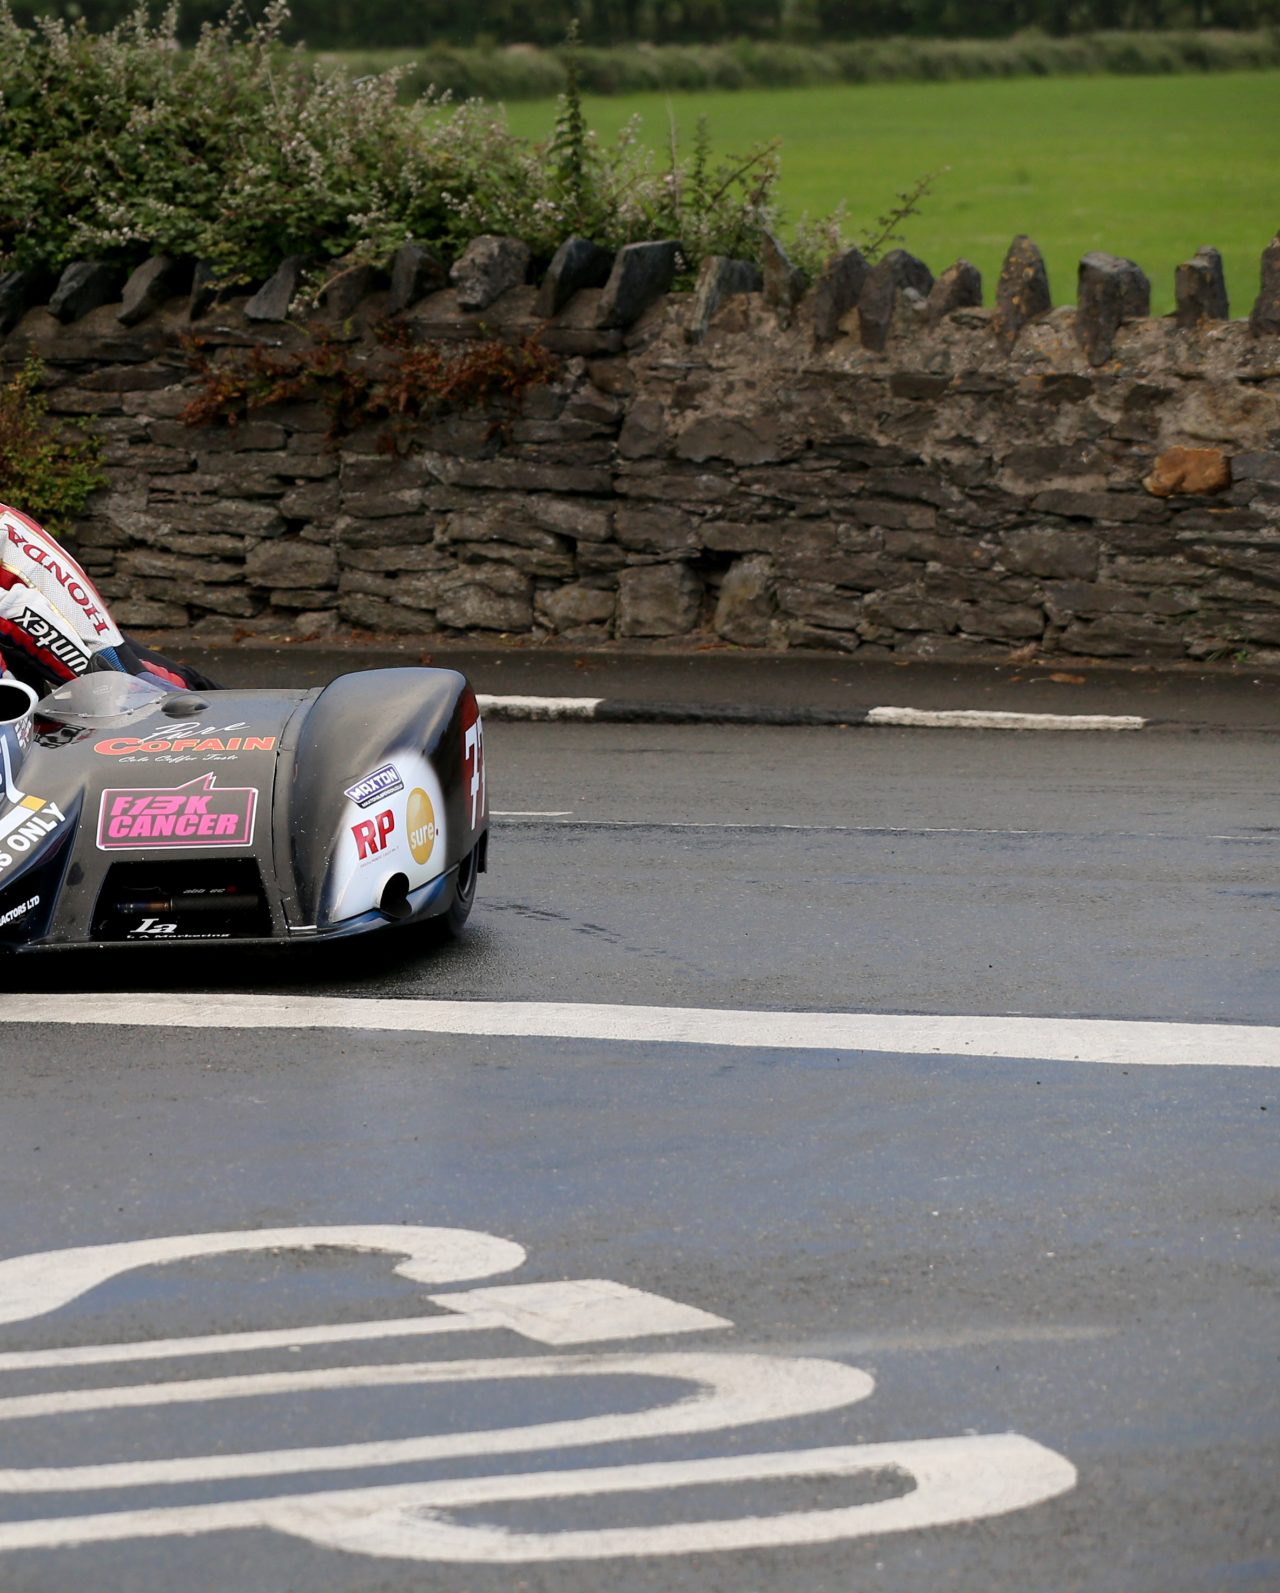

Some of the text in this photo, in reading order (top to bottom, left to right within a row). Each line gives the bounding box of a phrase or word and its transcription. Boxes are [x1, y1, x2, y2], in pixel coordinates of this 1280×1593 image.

[4, 523, 110, 636] HONDA
[349, 766, 398, 800] MAXTON
[465, 714, 486, 831] 77
[6, 801, 66, 852] ONLY
[108, 813, 240, 838] CANCER
[351, 809, 395, 860] RP
[410, 821, 435, 850] sure
[26, 895, 40, 910] LTD
